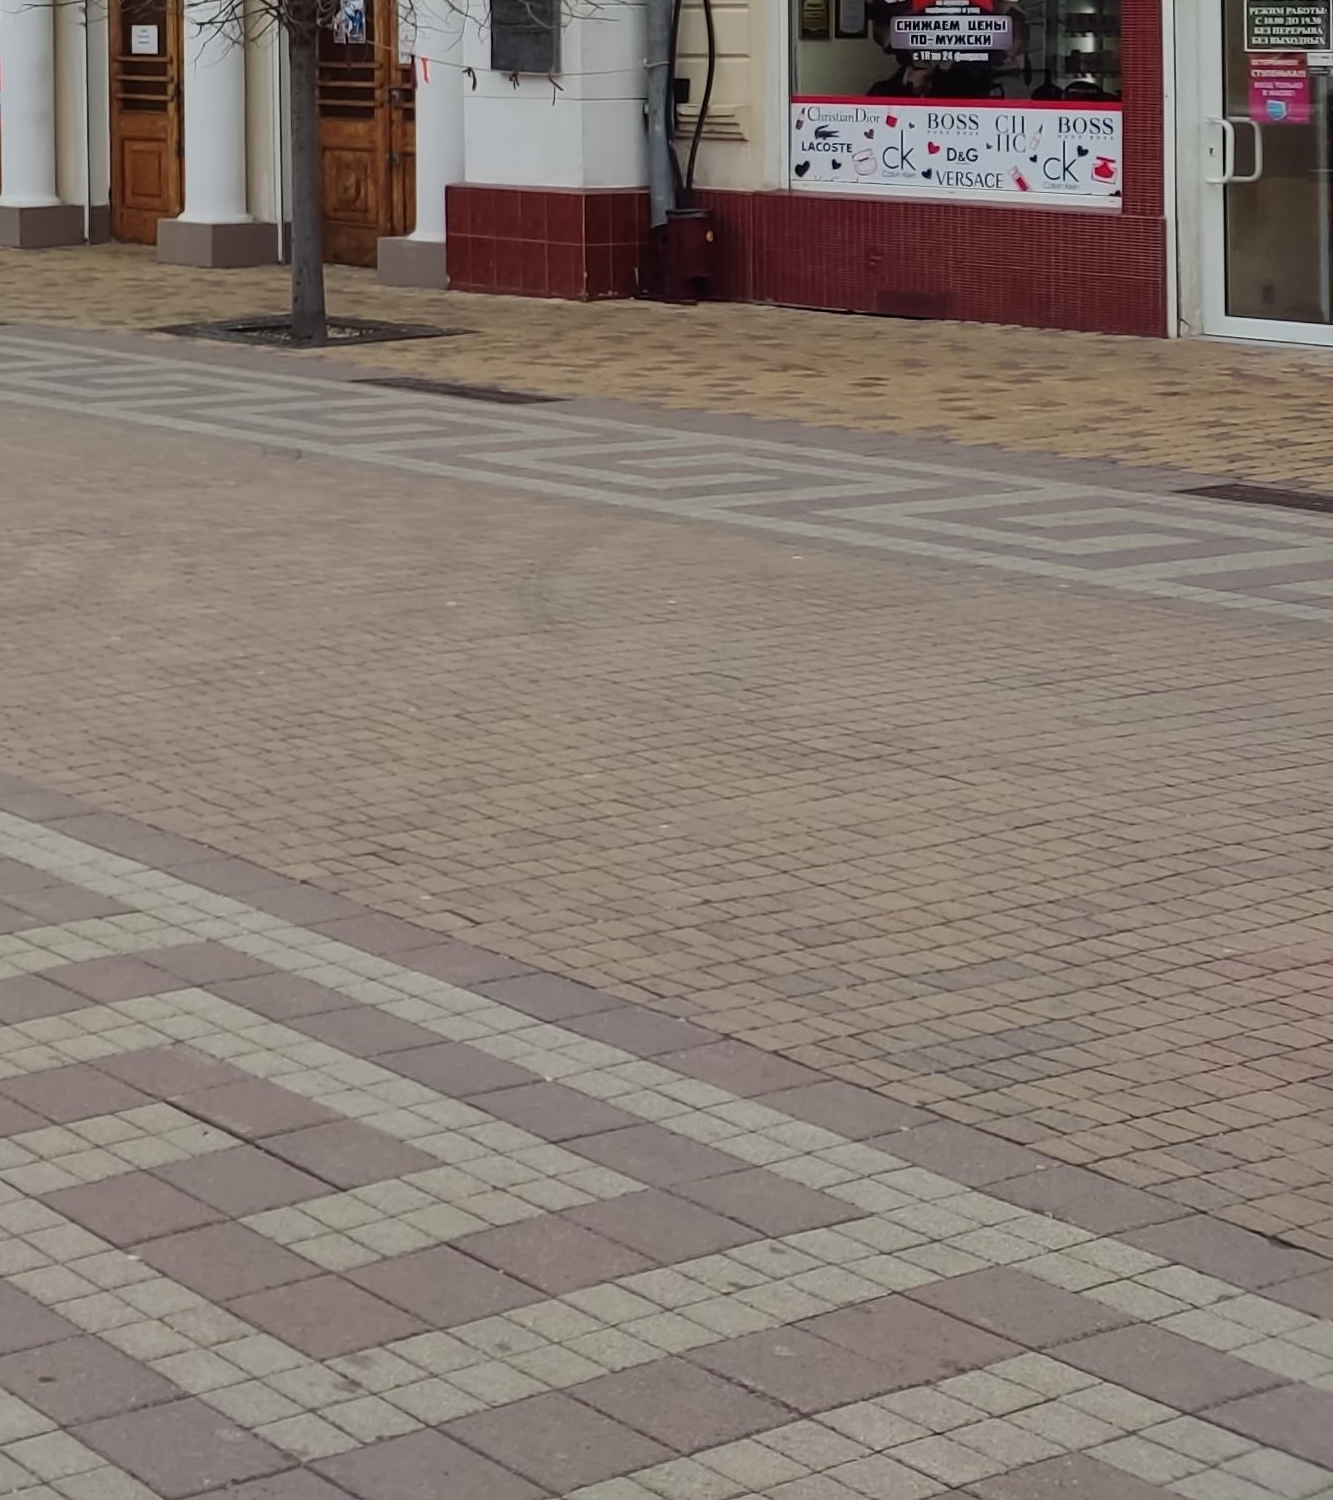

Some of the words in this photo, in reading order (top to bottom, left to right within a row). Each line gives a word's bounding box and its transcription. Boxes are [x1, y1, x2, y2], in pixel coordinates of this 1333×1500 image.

[896, 19, 960, 31] СНИЖАЕМ
[968, 20, 1006, 33] ЦЕНЫ
[910, 34, 991, 46] ПО-МУЖСКИ
[927, 113, 979, 131] BOSS
[1058, 117, 1114, 134] BOSS
[801, 141, 853, 153] LACOSTE
[946, 147, 979, 162] D&G
[936, 170, 1003, 189] VERSACE
